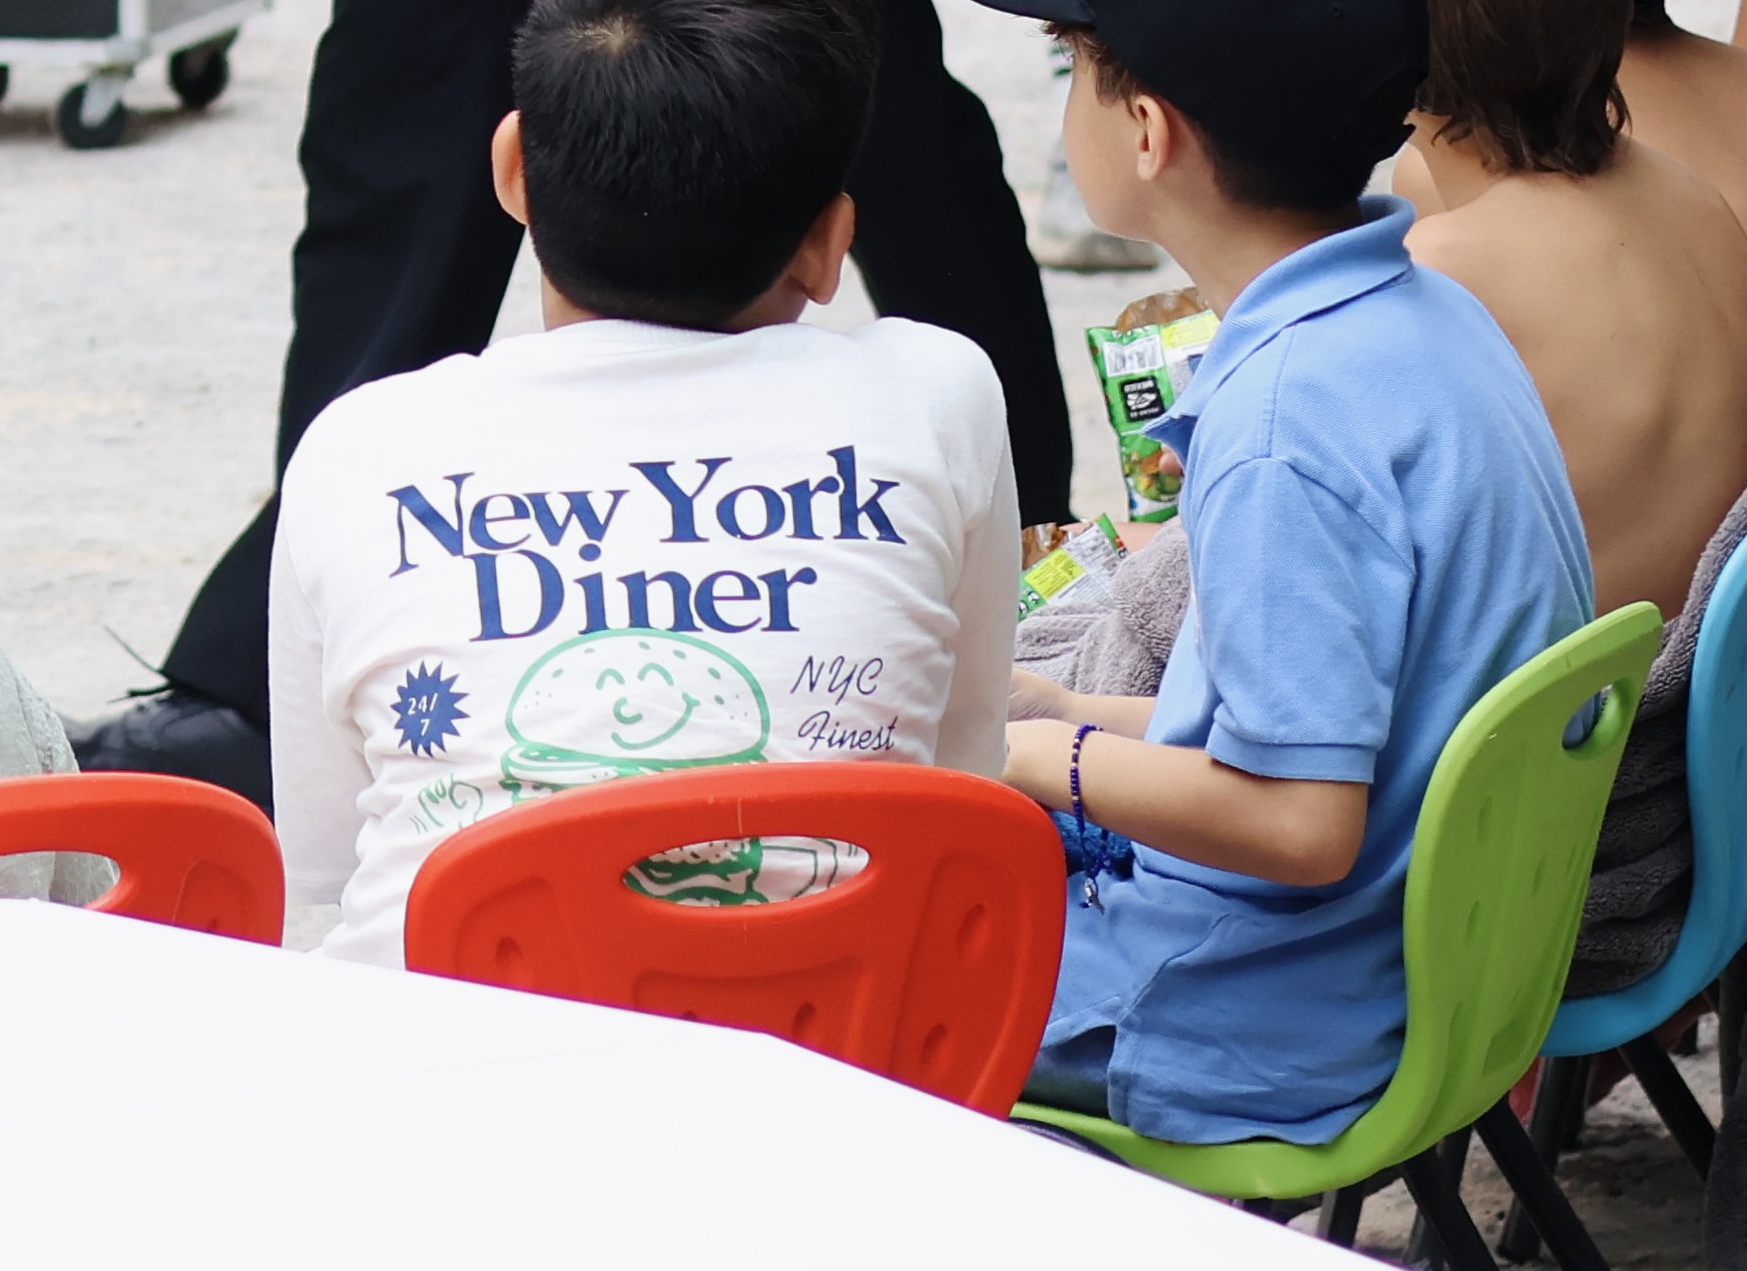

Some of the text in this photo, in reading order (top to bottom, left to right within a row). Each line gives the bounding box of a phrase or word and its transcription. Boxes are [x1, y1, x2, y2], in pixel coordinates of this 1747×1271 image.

[385, 444, 907, 579] New York
[462, 542, 819, 643] Diner
[407, 691, 439, 716] 24/
[789, 654, 884, 707] NYC
[419, 717, 431, 737] 7
[797, 709, 899, 752] Finest
